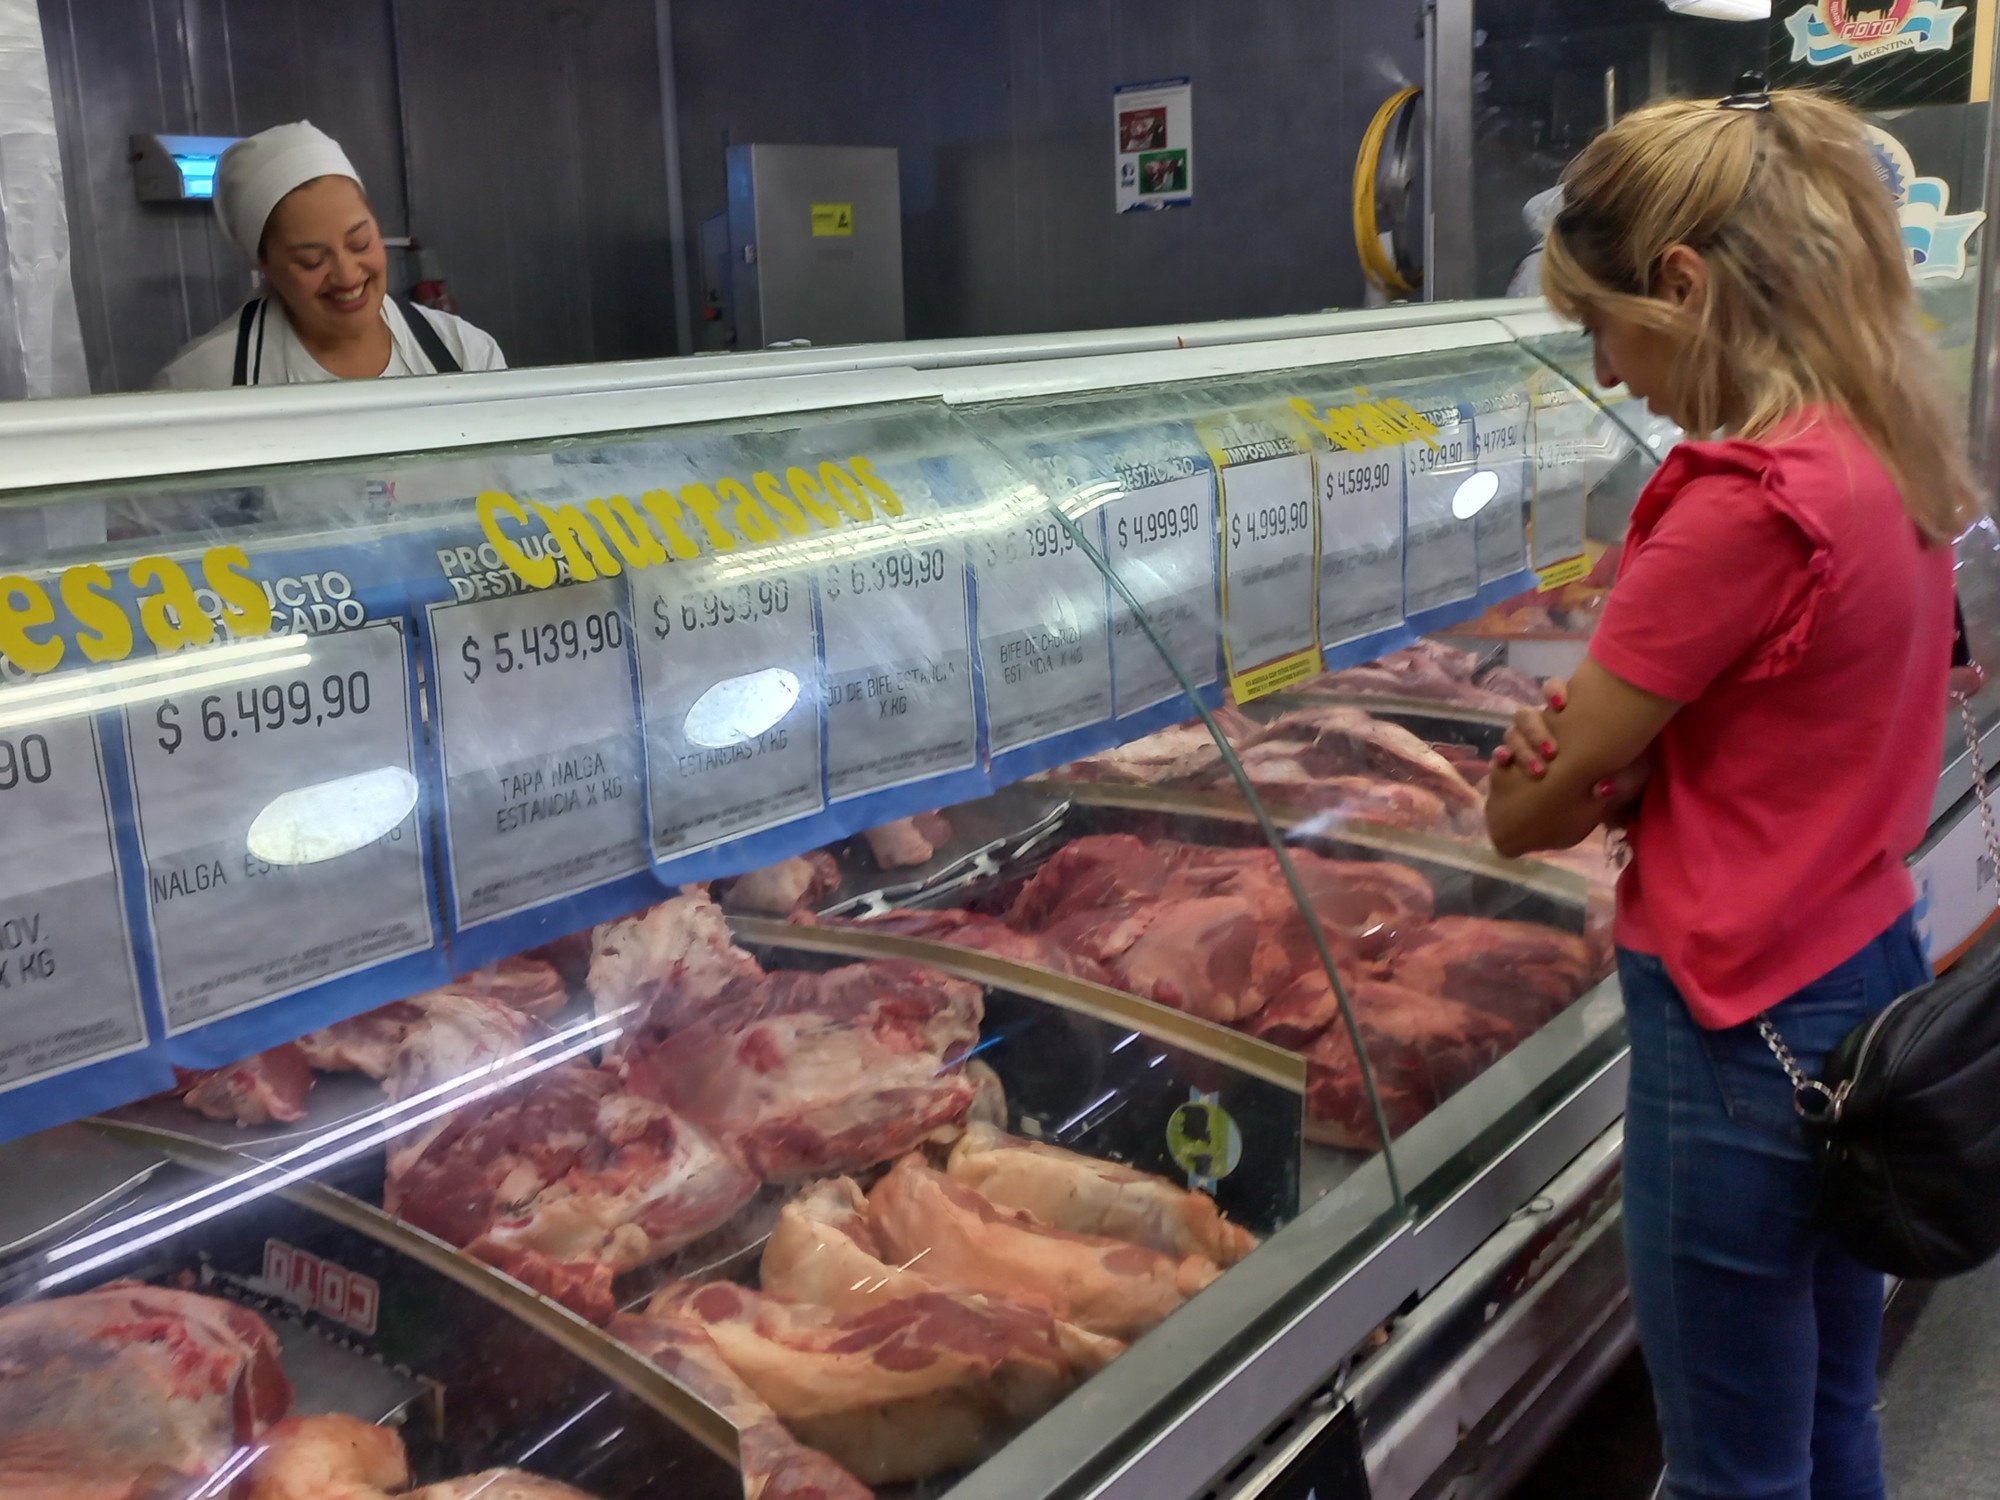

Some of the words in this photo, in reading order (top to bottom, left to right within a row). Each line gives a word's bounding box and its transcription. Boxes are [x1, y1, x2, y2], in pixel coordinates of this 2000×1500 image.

[1841, 19, 1898, 39] COTO
[1857, 38, 1914, 61] ARGENTINA
[1327, 472, 1334, 501] $
[1338, 463, 1390, 496] 4.599,90
[1118, 517, 1128, 550] $
[1133, 503, 1199, 544] 4.999,90
[1232, 513, 1241, 549] $
[1247, 501, 1308, 542] 4.999,90
[0, 545, 272, 674] esas
[653, 595, 670, 640] $
[461, 635, 482, 684] $
[493, 611, 623, 673] 5.439,90
[1001, 641, 1022, 664] BIFE
[868, 675, 892, 698] BIFE
[879, 700, 887, 718] X
[891, 696, 907, 717] KG
[155, 698, 183, 755] $
[200, 671, 370, 742] 6.499,90
[757, 734, 767, 754] X
[501, 768, 546, 802] TAPA
[552, 753, 606, 787] NALGA
[496, 789, 582, 833] ESTANCIA
[586, 785, 598, 806] X
[602, 776, 623, 801] KG
[153, 860, 228, 903] NALGA
[20, 949, 56, 985] KG
[264, 1239, 379, 1335] COTO
